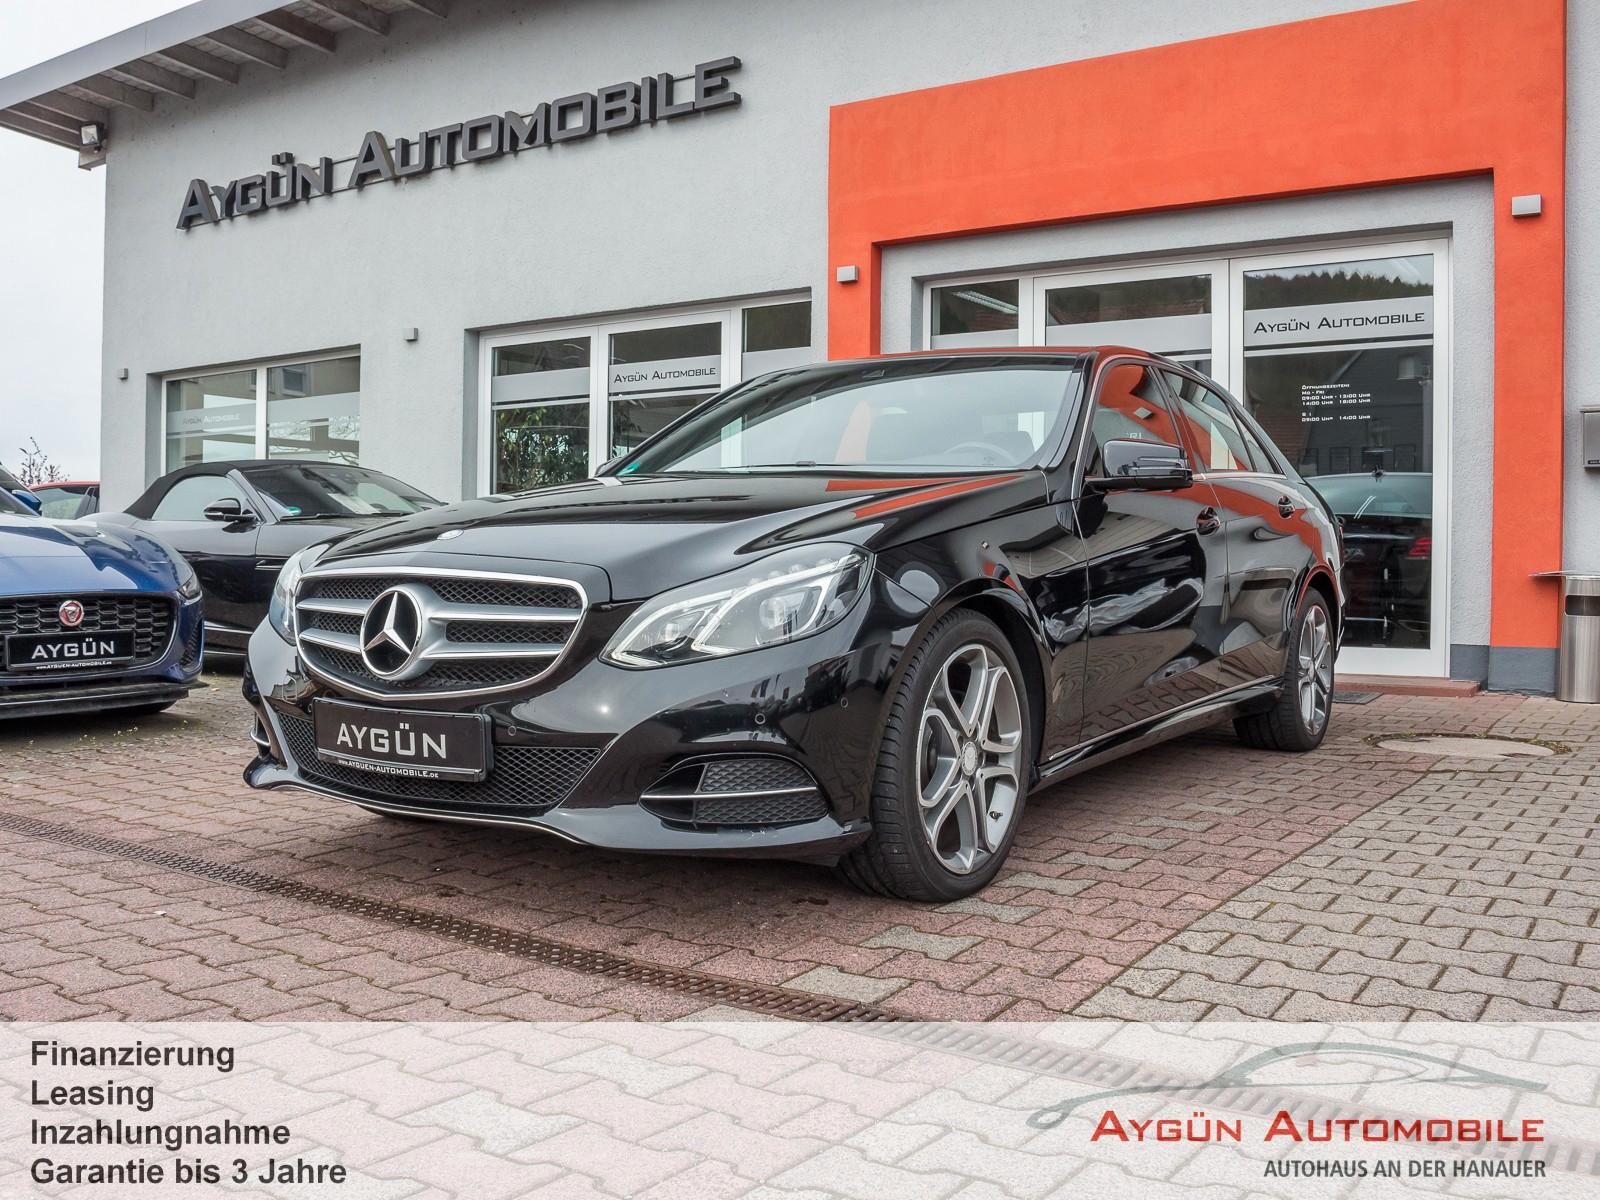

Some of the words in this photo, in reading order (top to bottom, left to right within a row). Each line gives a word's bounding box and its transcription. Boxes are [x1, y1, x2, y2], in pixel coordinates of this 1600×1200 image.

[176, 152, 333, 230] AYGÜN
[348, 56, 742, 187] AUTOMOBILE
[1253, 318, 1310, 334] AYGÜN
[1317, 312, 1425, 329] AUTOMOBILE
[614, 372, 648, 383] AYGÜN
[652, 367, 716, 380] AUTOMOBILE
[31, 638, 115, 660] AYGÜN
[336, 722, 447, 759] AYGÜN
